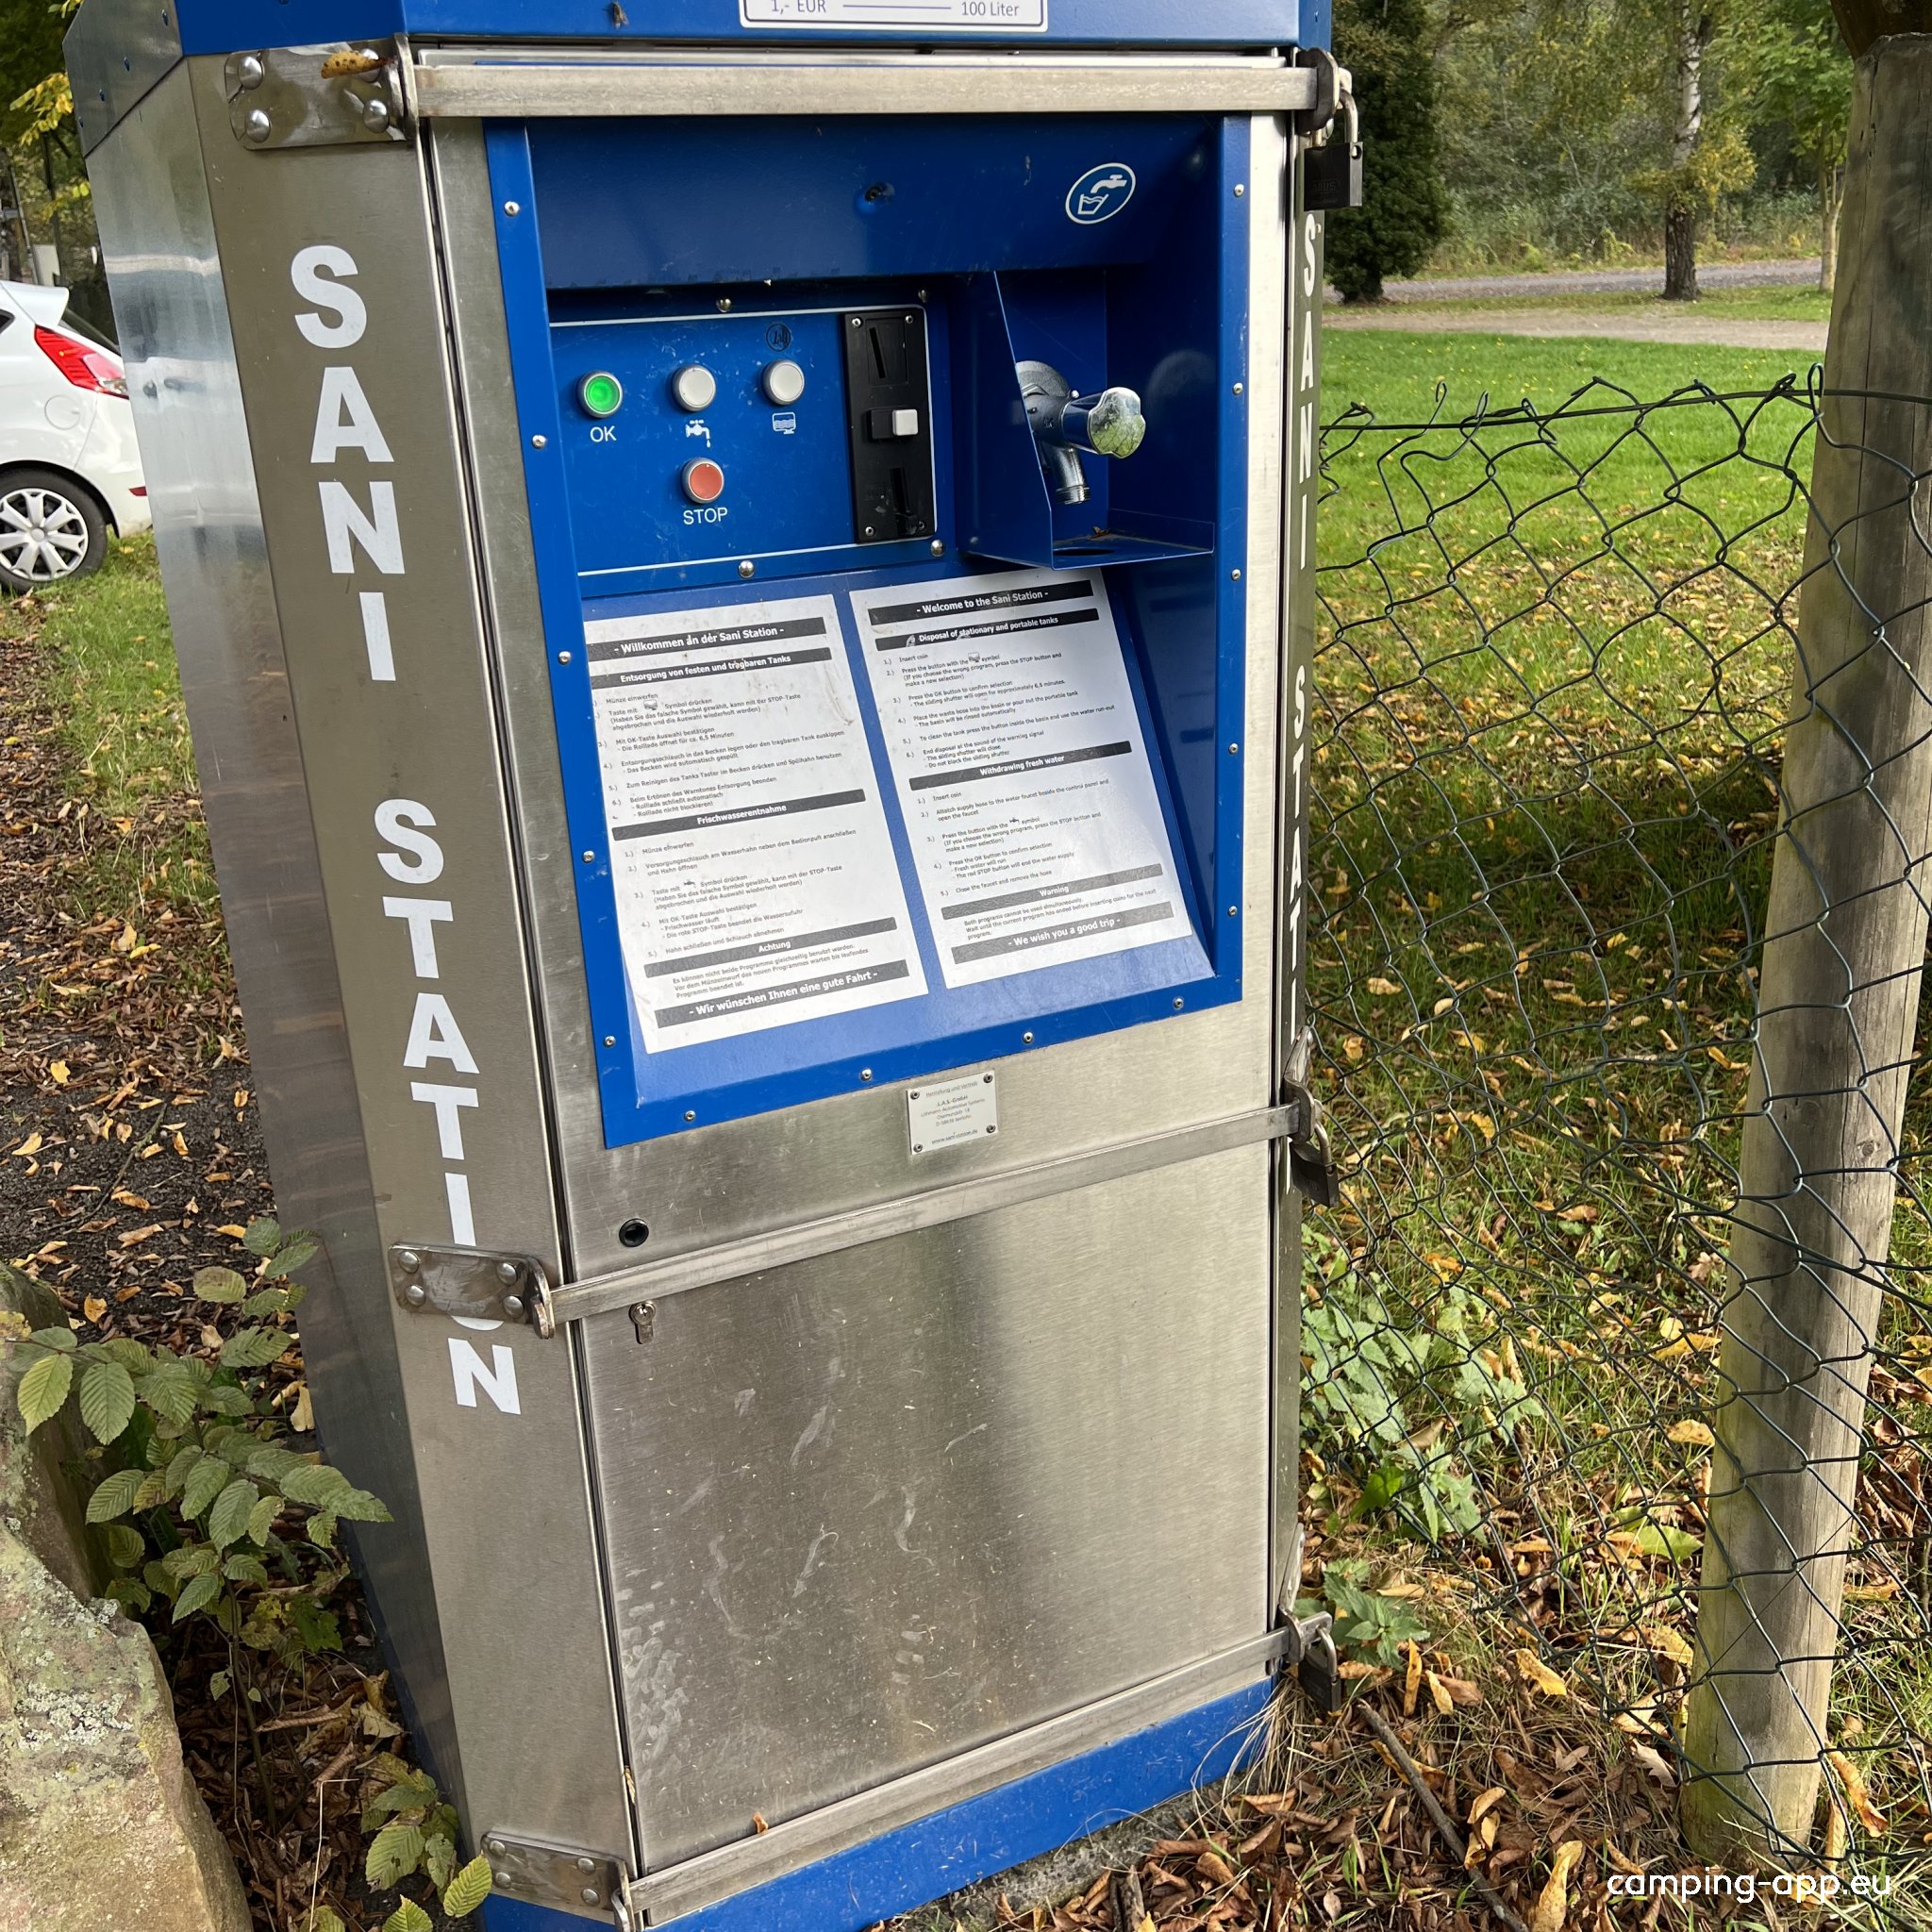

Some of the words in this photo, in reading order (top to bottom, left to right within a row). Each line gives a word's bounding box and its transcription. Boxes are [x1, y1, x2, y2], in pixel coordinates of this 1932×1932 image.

[797, 0, 826, 13] EUR
[961, 0, 986, 16] 100
[990, 1, 1019, 17] Liter
[1299, 212, 1317, 571] SANI
[590, 425, 617, 443] OK
[290, 244, 406, 682] SANI
[682, 506, 729, 525] STOP
[921, 602, 963, 612] Welcome
[974, 597, 991, 606] the
[991, 594, 1011, 604] Sani
[1011, 591, 1042, 601] Station
[620, 639, 684, 652] Willkommen
[700, 634, 717, 643] der
[719, 630, 741, 641] Sani
[742, 627, 777, 638] Station
[918, 630, 949, 641] Disposal
[958, 625, 994, 636] stationary
[994, 623, 1008, 631] and
[1008, 620, 1038, 630] portable
[1039, 617, 1059, 625] tanks
[620, 671, 667, 682] Entsorgung
[684, 665, 709, 675] festen
[711, 662, 726, 671] und
[727, 658, 766, 669] tragbaren
[767, 655, 791, 663] Tanks
[978, 762, 1024, 775] Withdrawing
[1024, 758, 1043, 768] fresh
[1043, 756, 1065, 764] water
[696, 805, 786, 824] Frischwasserentnahme
[1039, 886, 1069, 896] Warning
[1012, 935, 1028, 945] We
[1029, 930, 1050, 942] wish
[1051, 928, 1068, 940] you
[1076, 920, 1098, 934] good
[1098, 918, 1115, 928] trip
[758, 941, 791, 953] Achtung
[694, 1003, 714, 1014] Wir
[715, 993, 766, 1010] wünschen
[768, 987, 797, 1000] Ihnen
[799, 983, 821, 993] eine
[822, 978, 844, 991] gute
[845, 972, 872, 984] Fahrt
[374, 798, 522, 1416] STATIN
